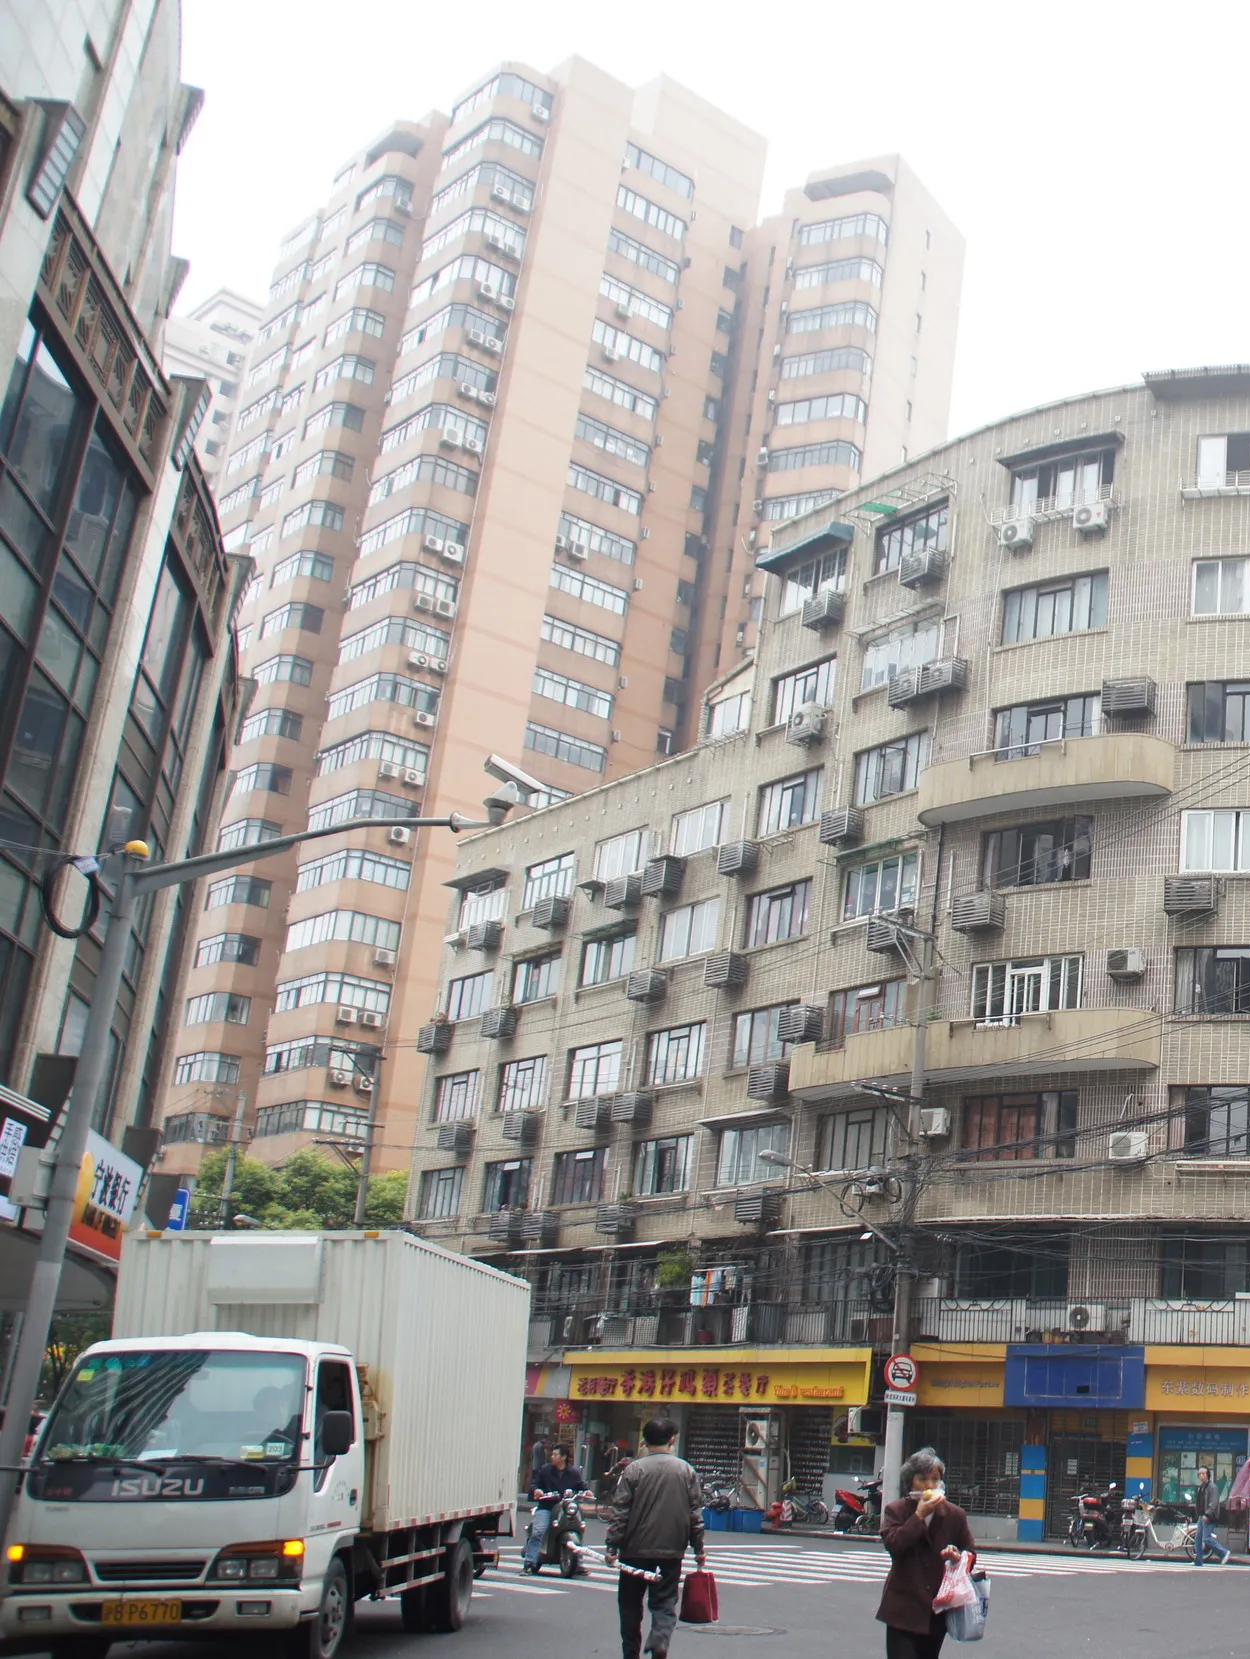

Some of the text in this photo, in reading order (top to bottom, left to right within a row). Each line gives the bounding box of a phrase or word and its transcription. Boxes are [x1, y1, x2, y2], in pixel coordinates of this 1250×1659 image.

[91, 1158, 132, 1216] 宁波银行
[111, 1478, 205, 1497] ISUZU
